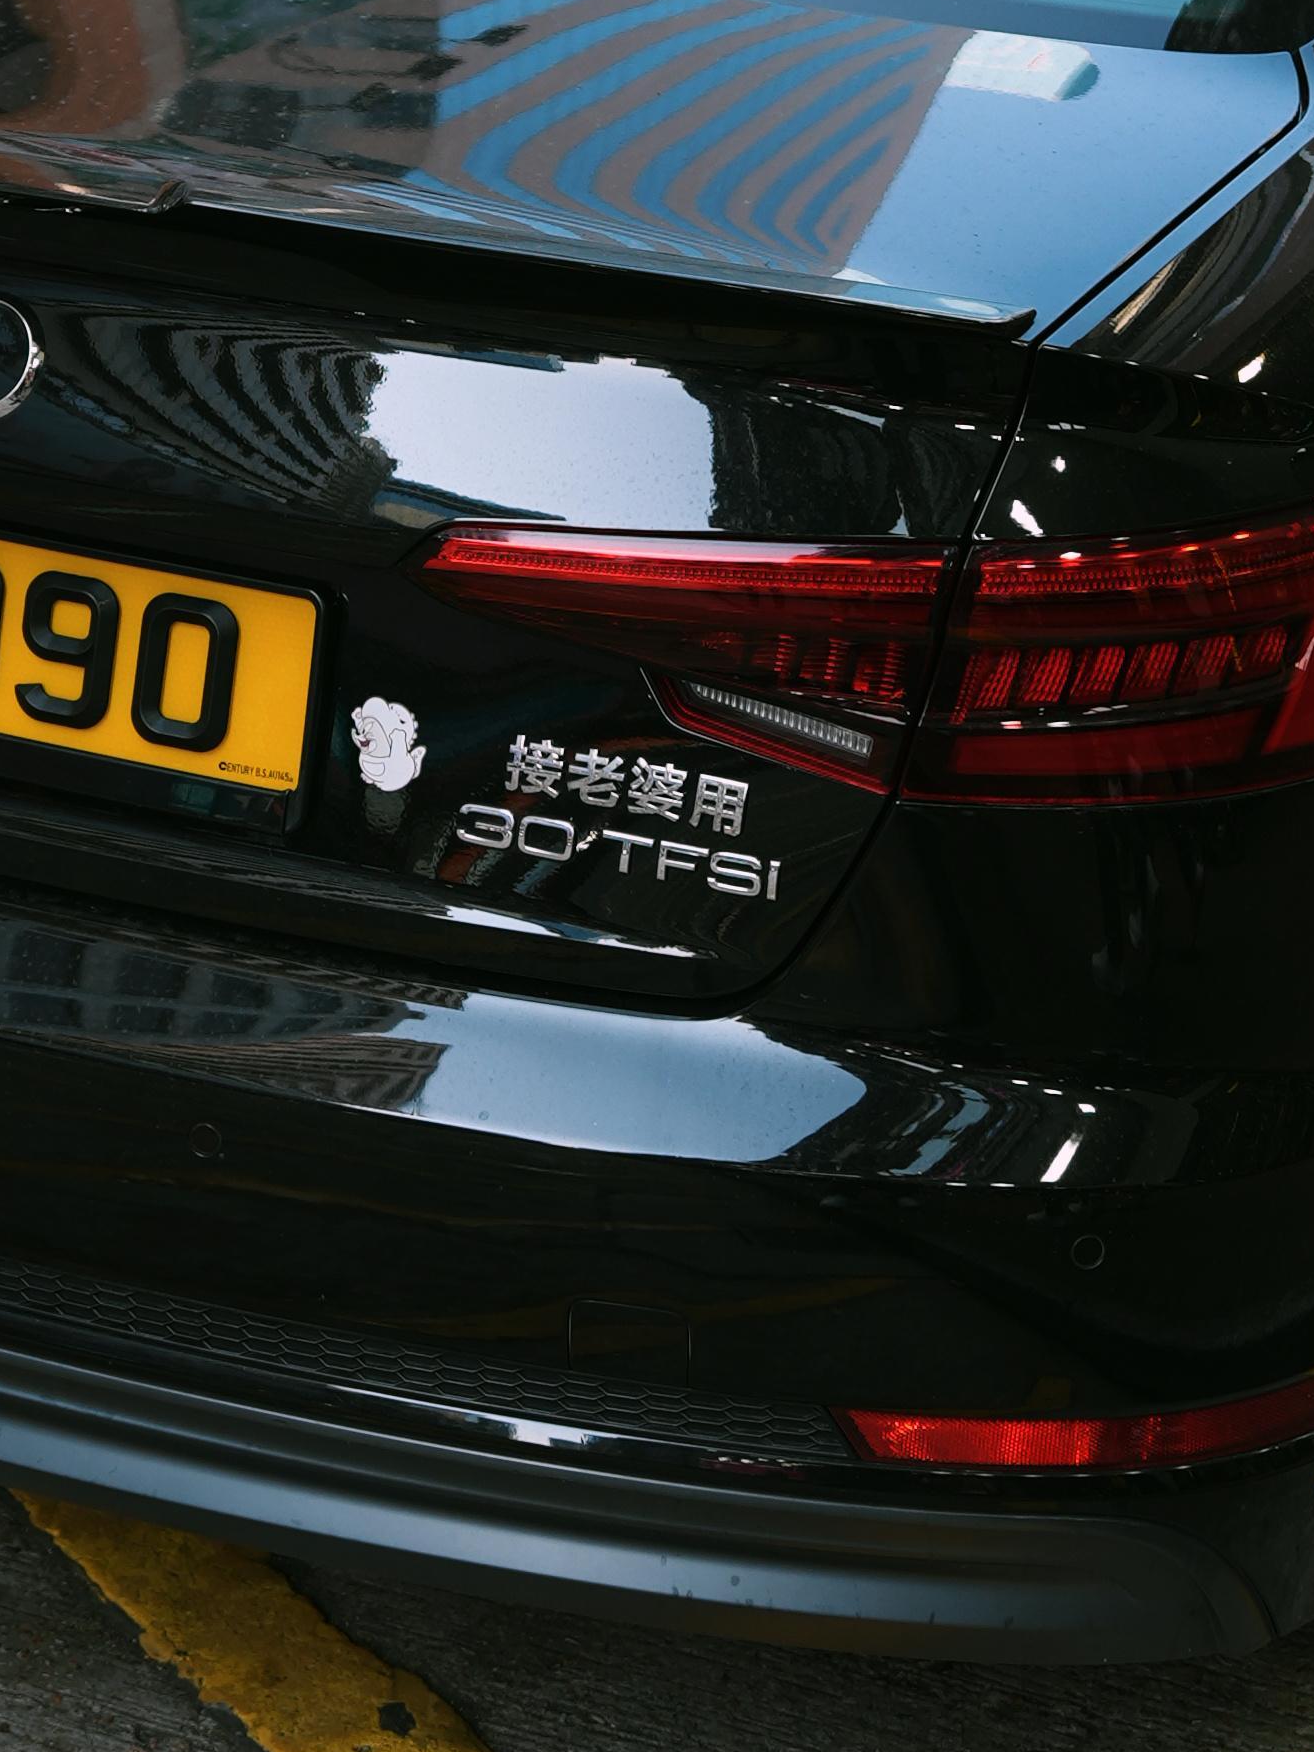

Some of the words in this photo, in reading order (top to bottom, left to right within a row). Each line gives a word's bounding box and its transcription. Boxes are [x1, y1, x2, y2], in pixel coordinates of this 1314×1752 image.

[218, 761, 254, 774] CENTURY
[504, 734, 749, 837] 接老婆用
[456, 803, 575, 862] 30
[602, 829, 782, 901] TFSI
